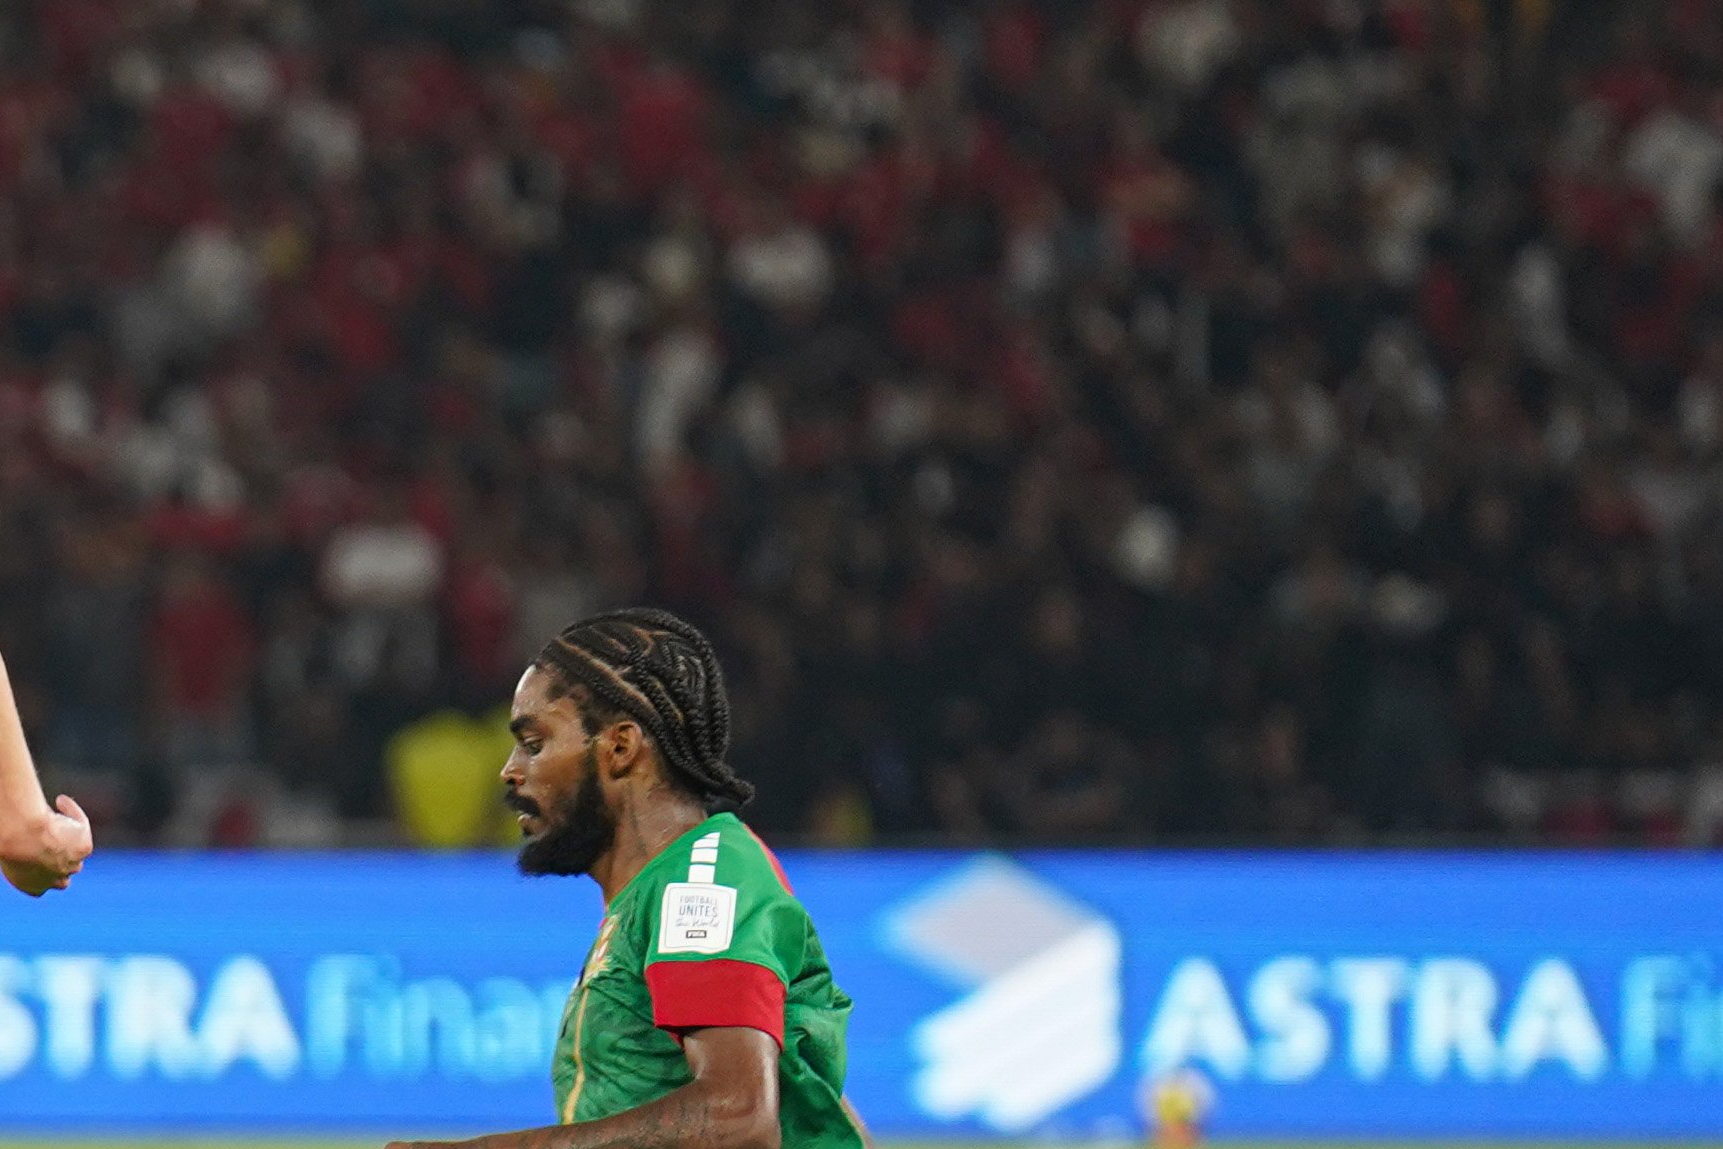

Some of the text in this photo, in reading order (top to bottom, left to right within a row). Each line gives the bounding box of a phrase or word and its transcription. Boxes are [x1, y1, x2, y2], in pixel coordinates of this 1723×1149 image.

[679, 904, 718, 918] UNITES
[1142, 955, 1723, 1082] ASTRA Fi
